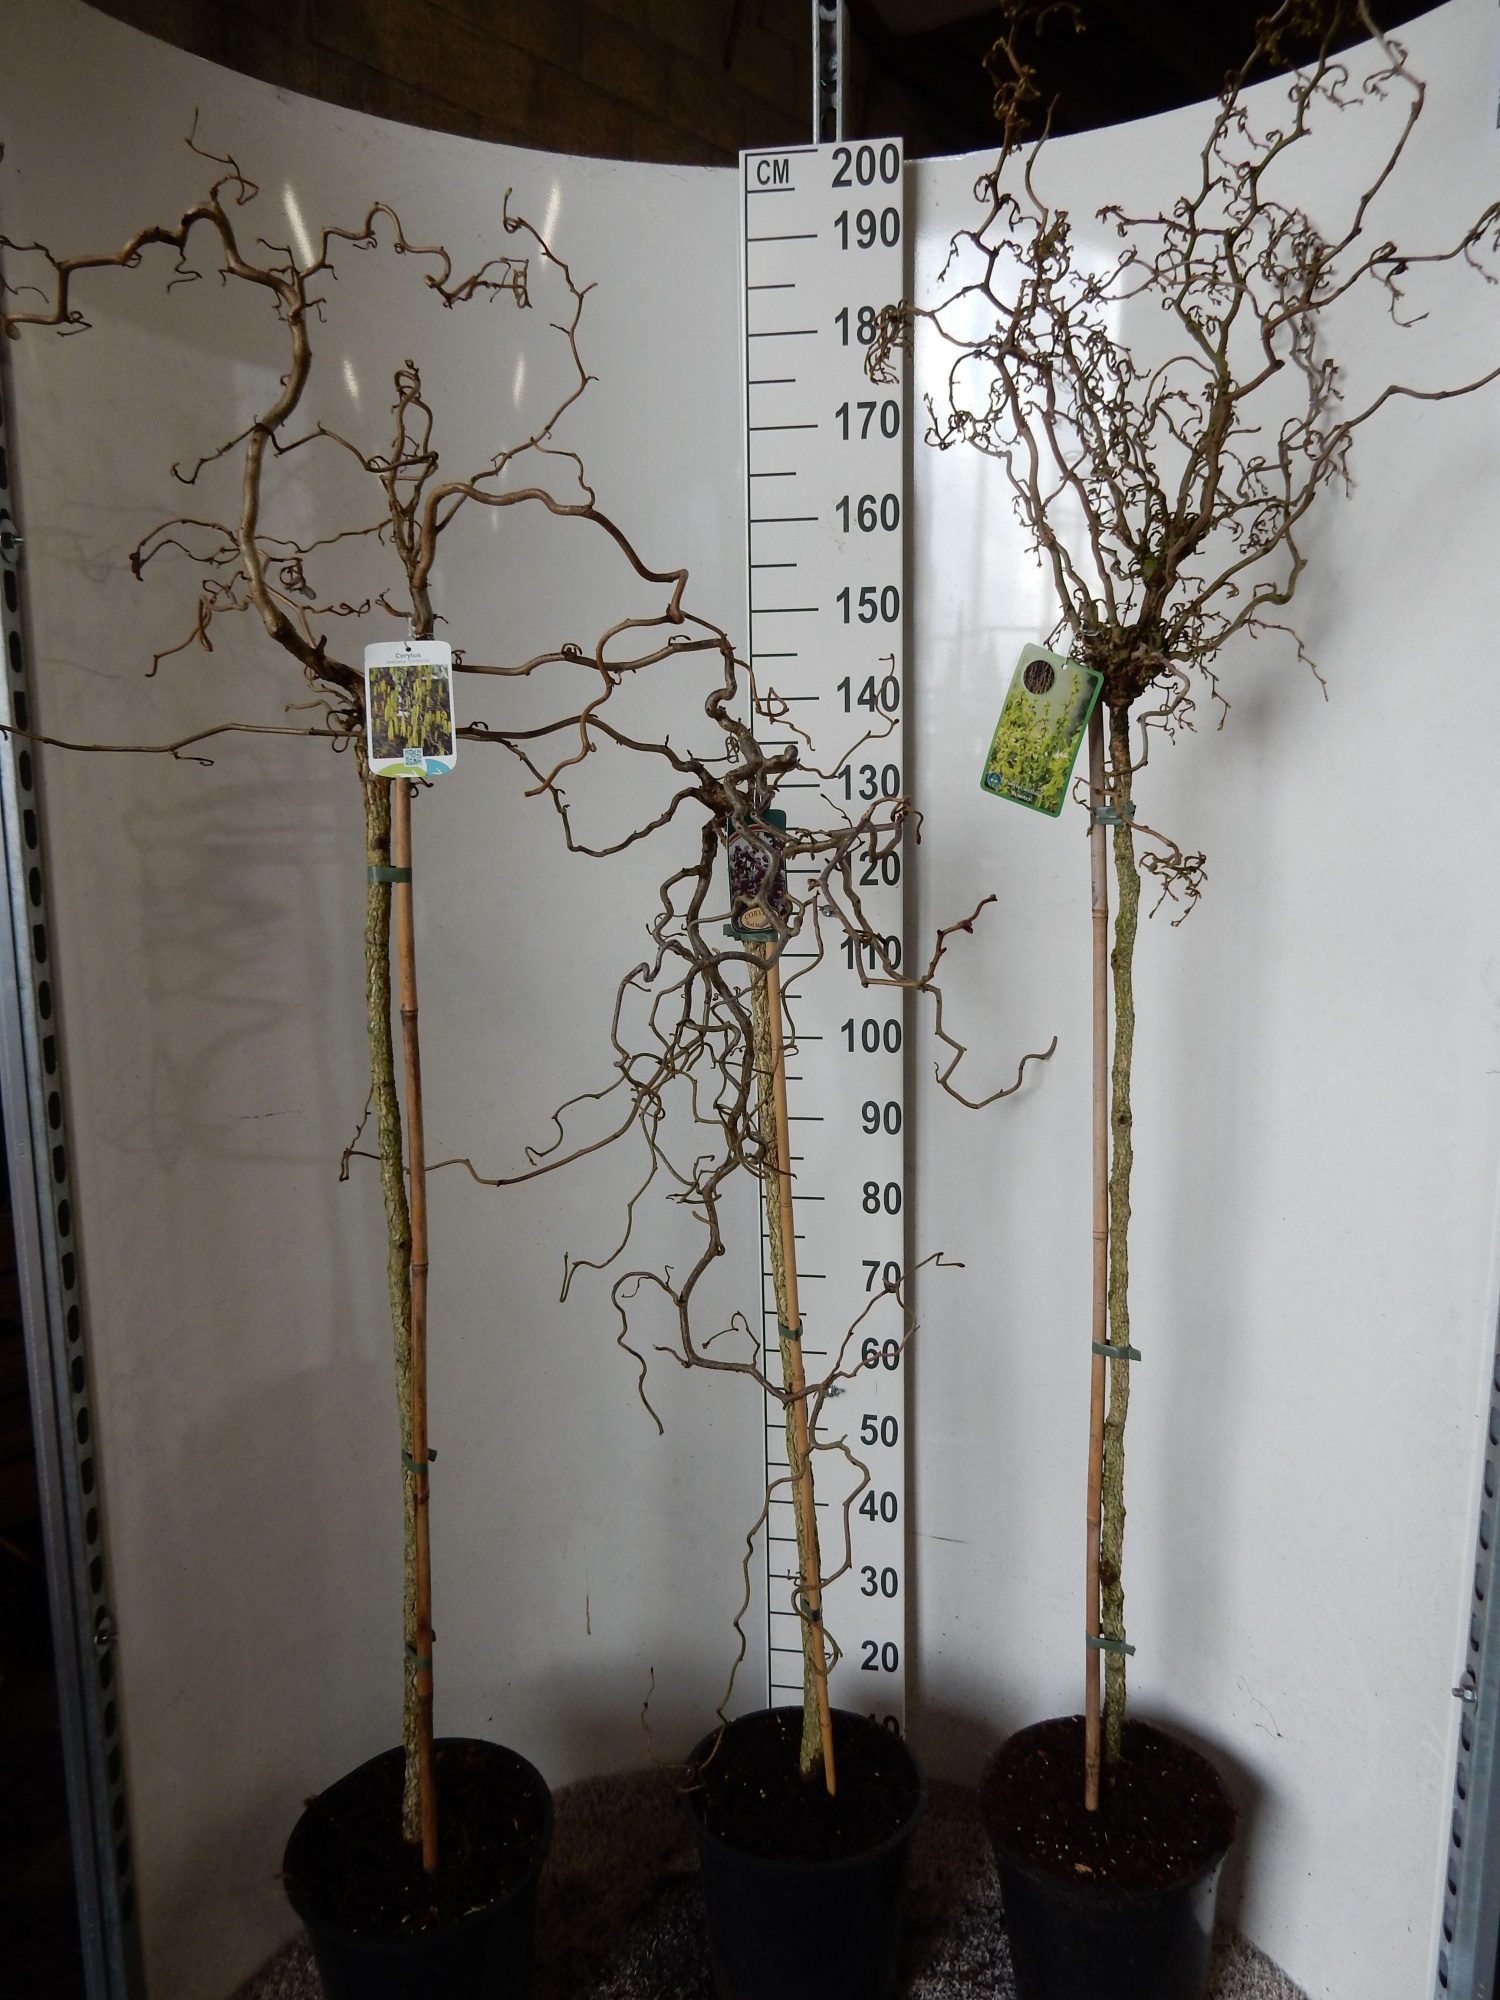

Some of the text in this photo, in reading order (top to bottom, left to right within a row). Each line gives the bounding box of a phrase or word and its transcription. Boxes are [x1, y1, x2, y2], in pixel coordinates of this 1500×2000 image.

[756, 159, 790, 185] CM
[831, 143, 900, 188] 200
[834, 206, 901, 250] 190
[835, 400, 900, 440] 170
[835, 493, 900, 533] 160
[836, 585, 900, 624] 150
[395, 652, 421, 660] Corylus
[837, 675, 900, 713] 140
[838, 763, 900, 800] 130
[840, 935, 902, 970] 110
[841, 1018, 902, 1054] 100
[861, 1100, 902, 1135] 90
[862, 1181, 902, 1215] 80
[862, 1259, 901, 1293] 70
[861, 1337, 900, 1371] 60
[860, 1413, 899, 1448] 50
[859, 1489, 898, 1523] 40
[860, 1565, 898, 1598] 30
[860, 1639, 899, 1673] 20
